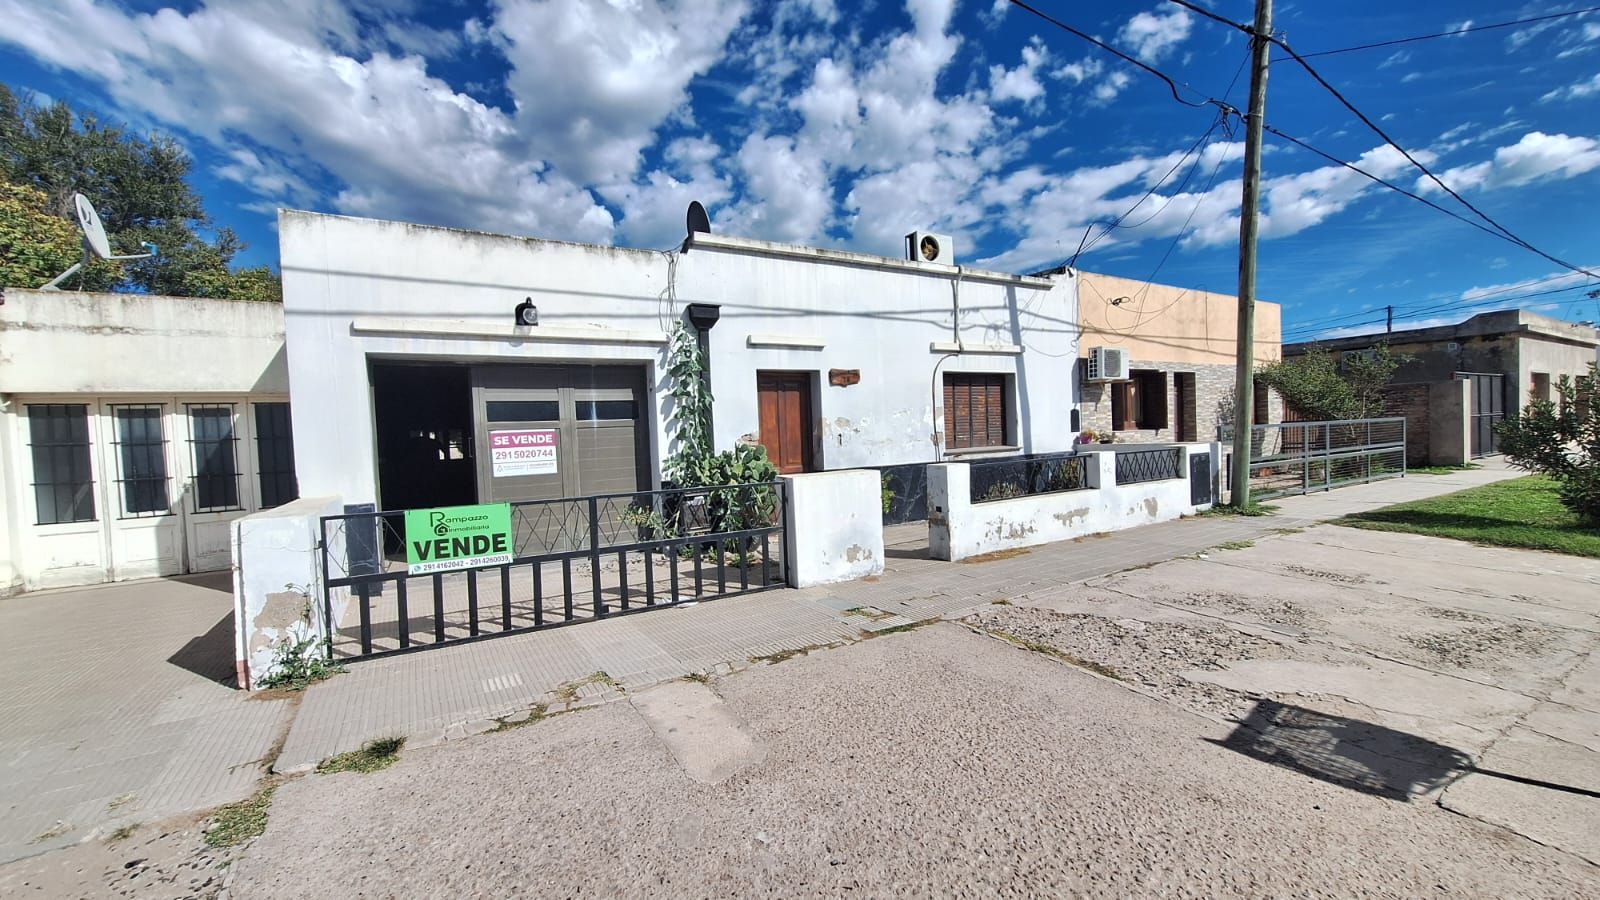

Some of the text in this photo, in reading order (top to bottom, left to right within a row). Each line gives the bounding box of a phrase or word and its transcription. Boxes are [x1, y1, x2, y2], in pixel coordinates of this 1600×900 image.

[494, 434, 553, 445] SE VENDE
[430, 511, 489, 527] Rampazzo
[413, 533, 507, 560] VENDE
